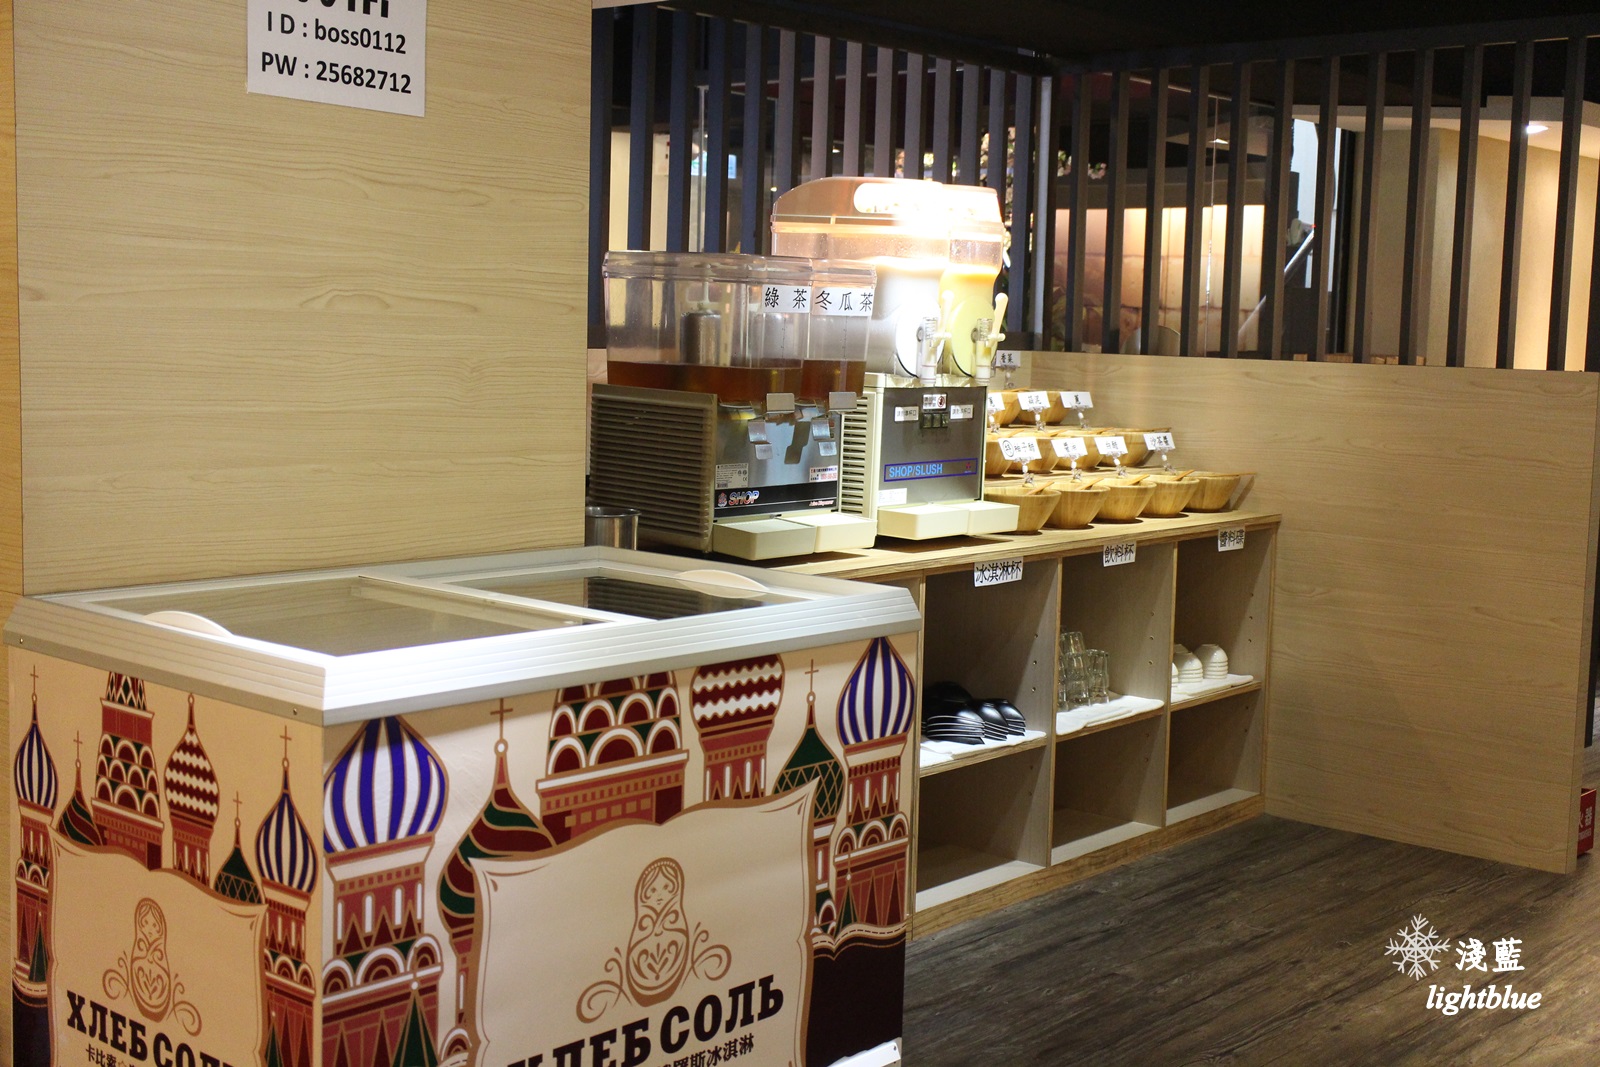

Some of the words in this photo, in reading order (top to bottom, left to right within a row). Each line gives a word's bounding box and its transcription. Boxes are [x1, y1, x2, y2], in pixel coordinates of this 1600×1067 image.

[315, 18, 406, 54] boss0112
[316, 61, 412, 94] 25682712
[764, 287, 807, 309] 綠茶
[815, 290, 874, 312] 冬瓜茶
[889, 463, 943, 478] SHOP/SLUSH
[728, 490, 760, 506] SHOP
[1104, 543, 1134, 564] 飲料杯
[975, 561, 1022, 584] 冰淇淋杯
